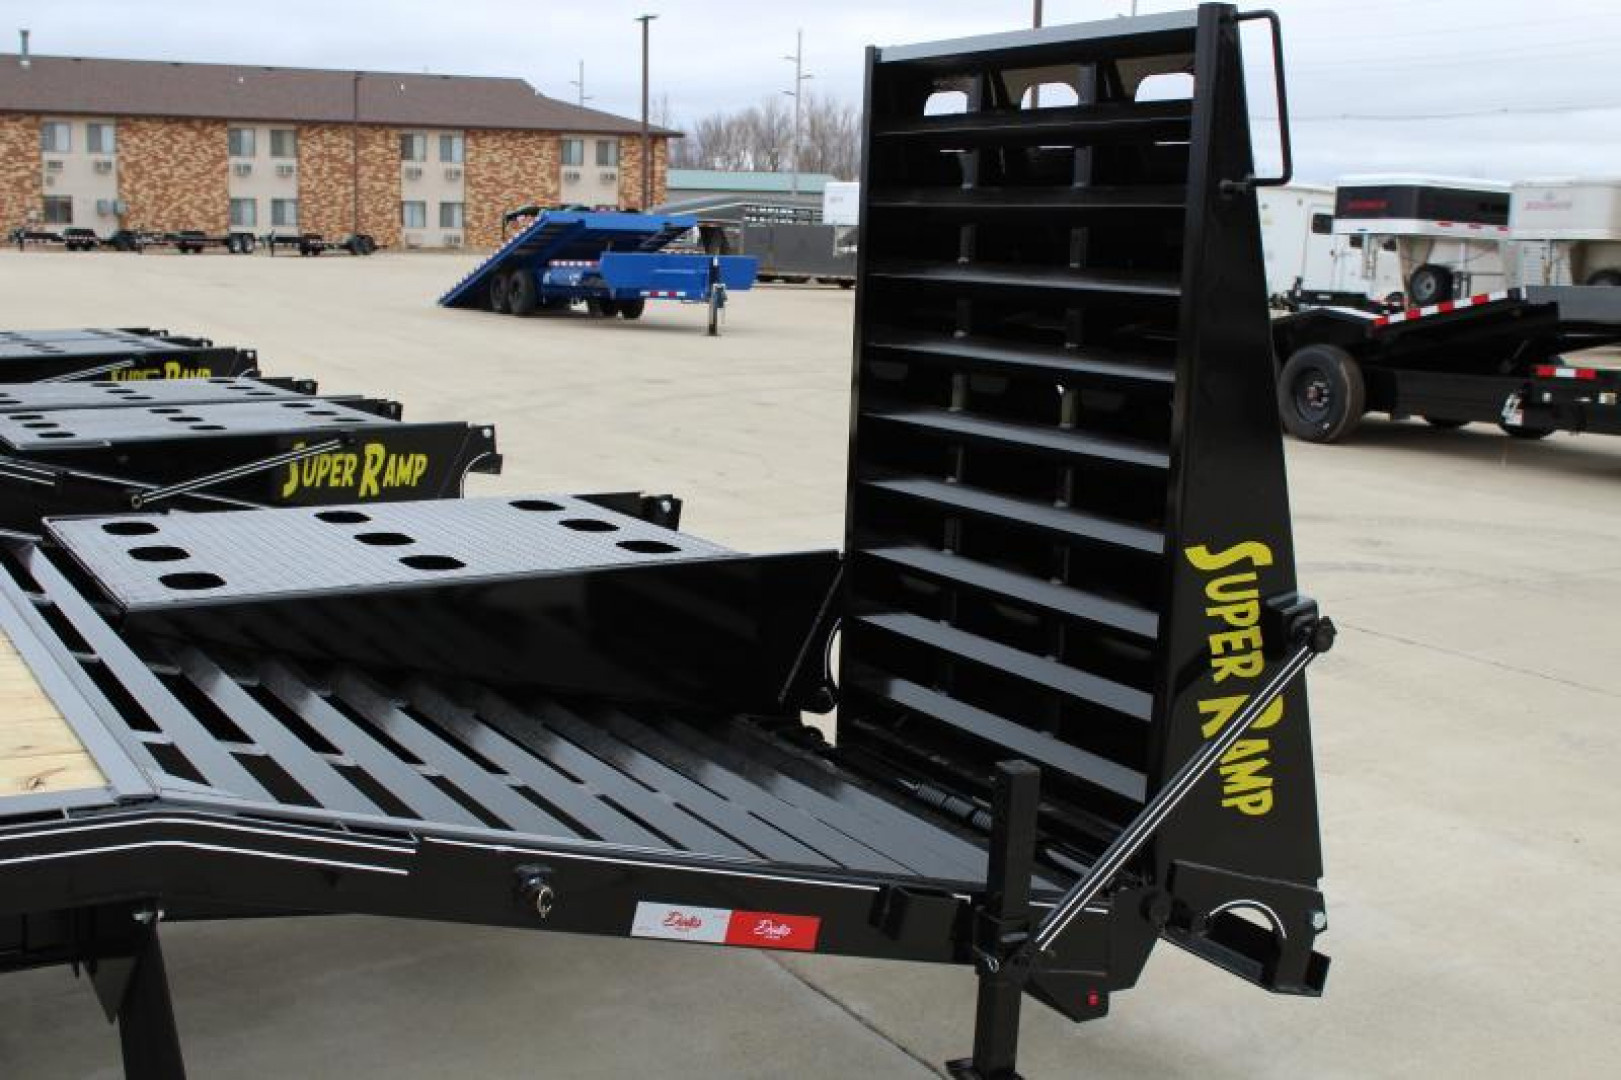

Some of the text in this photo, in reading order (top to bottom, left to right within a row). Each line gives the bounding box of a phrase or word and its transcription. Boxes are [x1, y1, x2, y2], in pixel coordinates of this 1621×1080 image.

[282, 442, 428, 498] SUPER RAMP
[1184, 540, 1284, 817] SUPER RAMP
